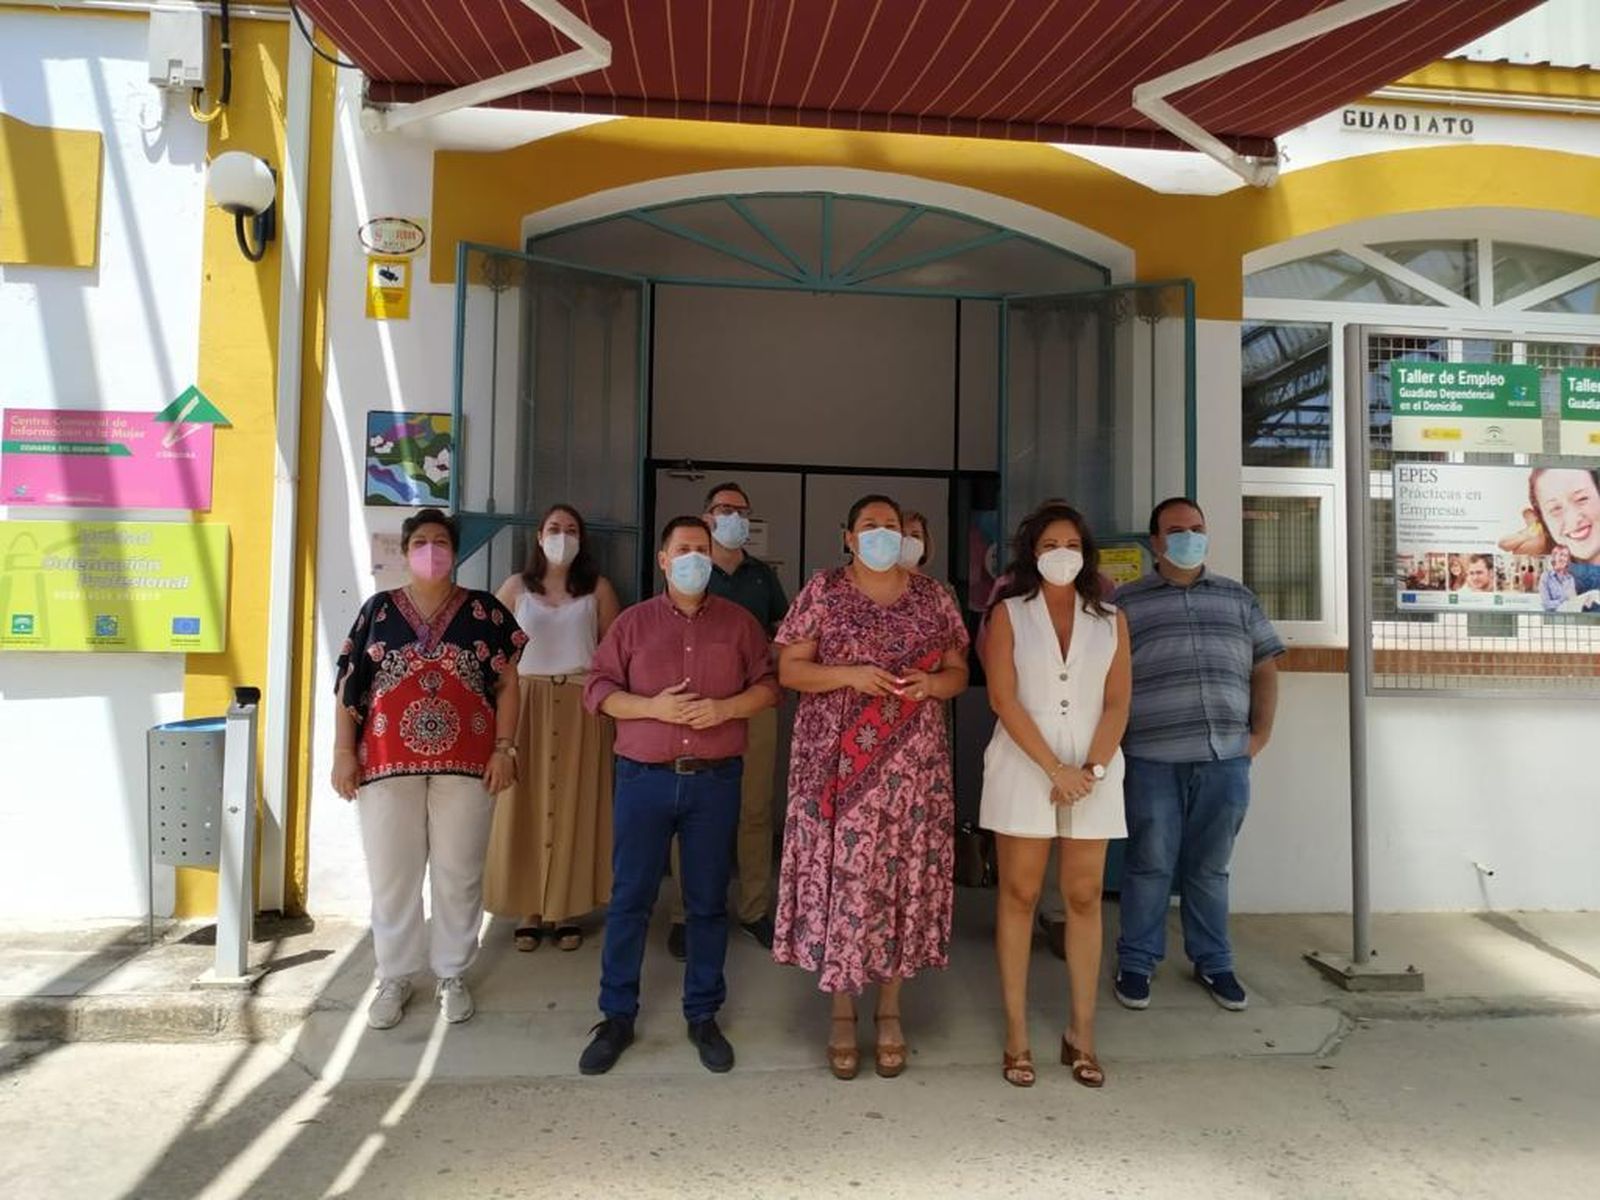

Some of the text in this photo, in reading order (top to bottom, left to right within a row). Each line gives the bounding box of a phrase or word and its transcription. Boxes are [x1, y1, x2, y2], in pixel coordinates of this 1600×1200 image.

[1343, 110, 1474, 134] GUADIATO
[1398, 369, 1505, 386] Taller de Empleo
[1440, 389, 1495, 400] Dependencia
[1423, 401, 1463, 412] Domicilio
[112, 419, 128, 428] de
[10, 426, 81, 438] Informa
[1400, 468, 1438, 484] EPES
[1400, 487, 1482, 501] Prácticas en
[1400, 503, 1467, 520] Empresas
[79, 574, 189, 590] sional
